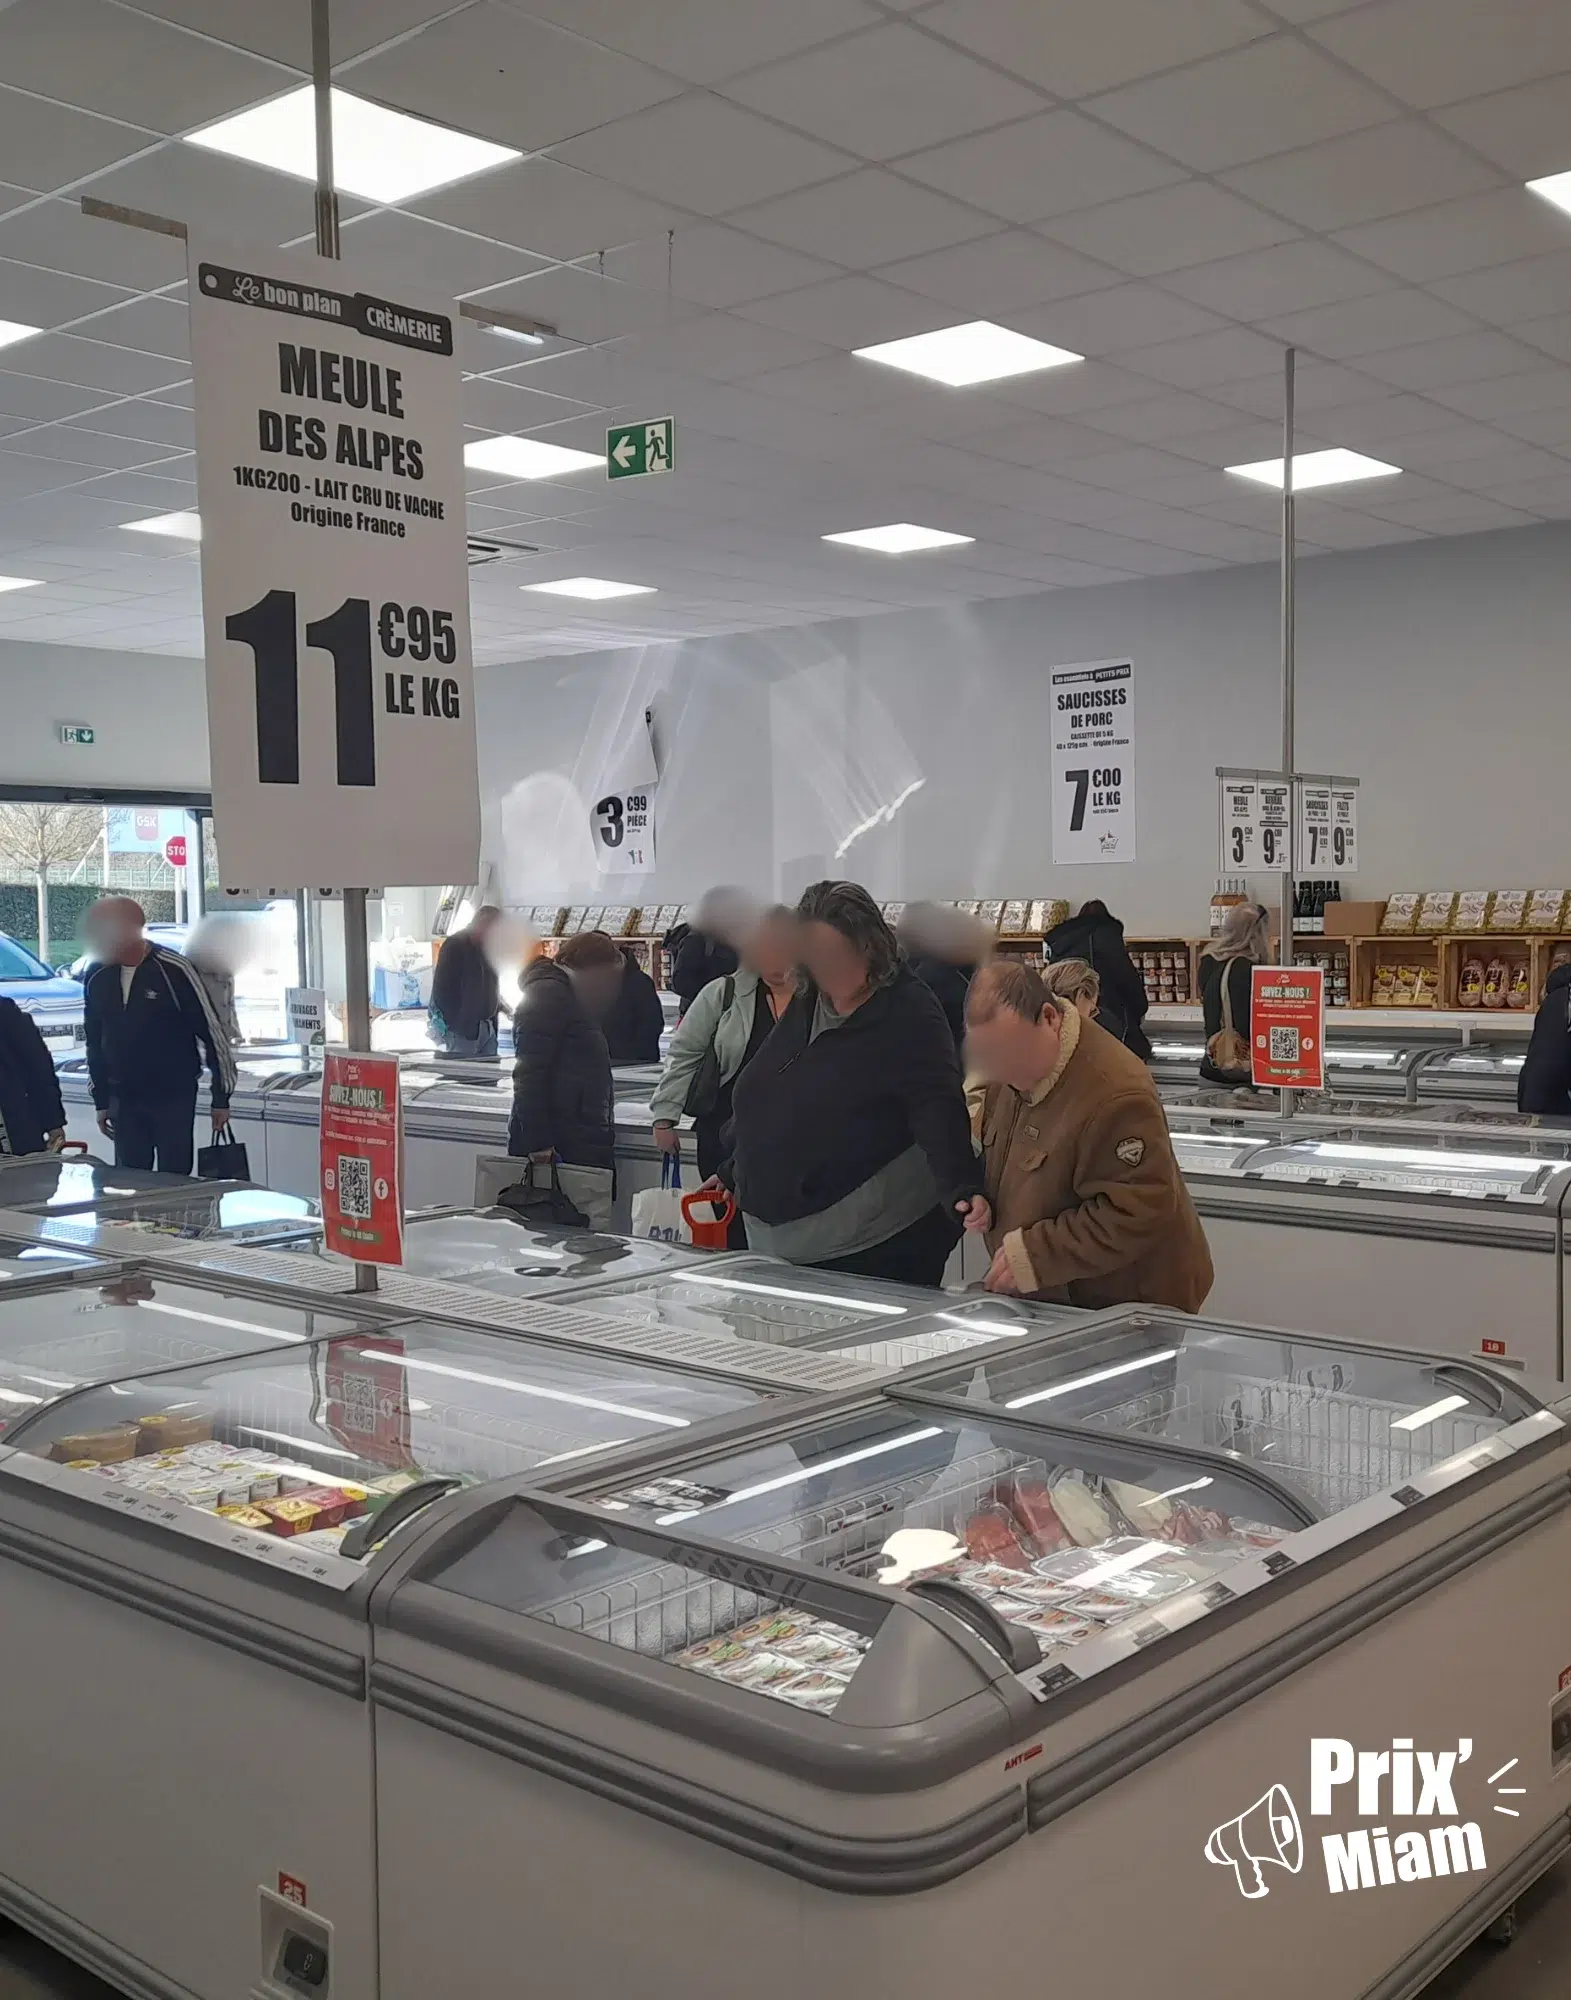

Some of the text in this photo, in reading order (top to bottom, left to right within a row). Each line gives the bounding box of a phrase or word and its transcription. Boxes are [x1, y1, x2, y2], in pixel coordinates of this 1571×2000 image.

[232, 275, 342, 317] Le bon plan
[366, 304, 443, 345] CRÈMERIE
[278, 342, 405, 420] MEULE
[258, 408, 425, 481] DES ALPES
[232, 466, 301, 495] 1KG200
[314, 477, 349, 503] LAIT
[351, 483, 383, 508] CRU
[384, 489, 402, 511] DE
[403, 493, 446, 521] VACHE
[291, 501, 407, 539] Origine France
[225, 589, 457, 787] 11 €95
[1095, 667, 1130, 680] PETITS PRIX
[384, 672, 461, 719] LE KG
[1057, 688, 1127, 711] SAUCISSES
[1070, 711, 1113, 728] DE PORC
[1065, 768, 1121, 832] 7 €00
[1092, 791, 1121, 807] LE KG
[597, 795, 647, 848] 3 €99
[627, 813, 647, 827] PIÈCE
[167, 845, 185, 856] STO
[1232, 826, 1244, 863] 3
[1263, 828, 1275, 864] 9
[1308, 826, 1318, 865] 7
[1333, 826, 1345, 866] 9
[1260, 986, 1305, 998] SUIVEZ-NOUS
[329, 1085, 376, 1108] SUIVEZ-NOUS
